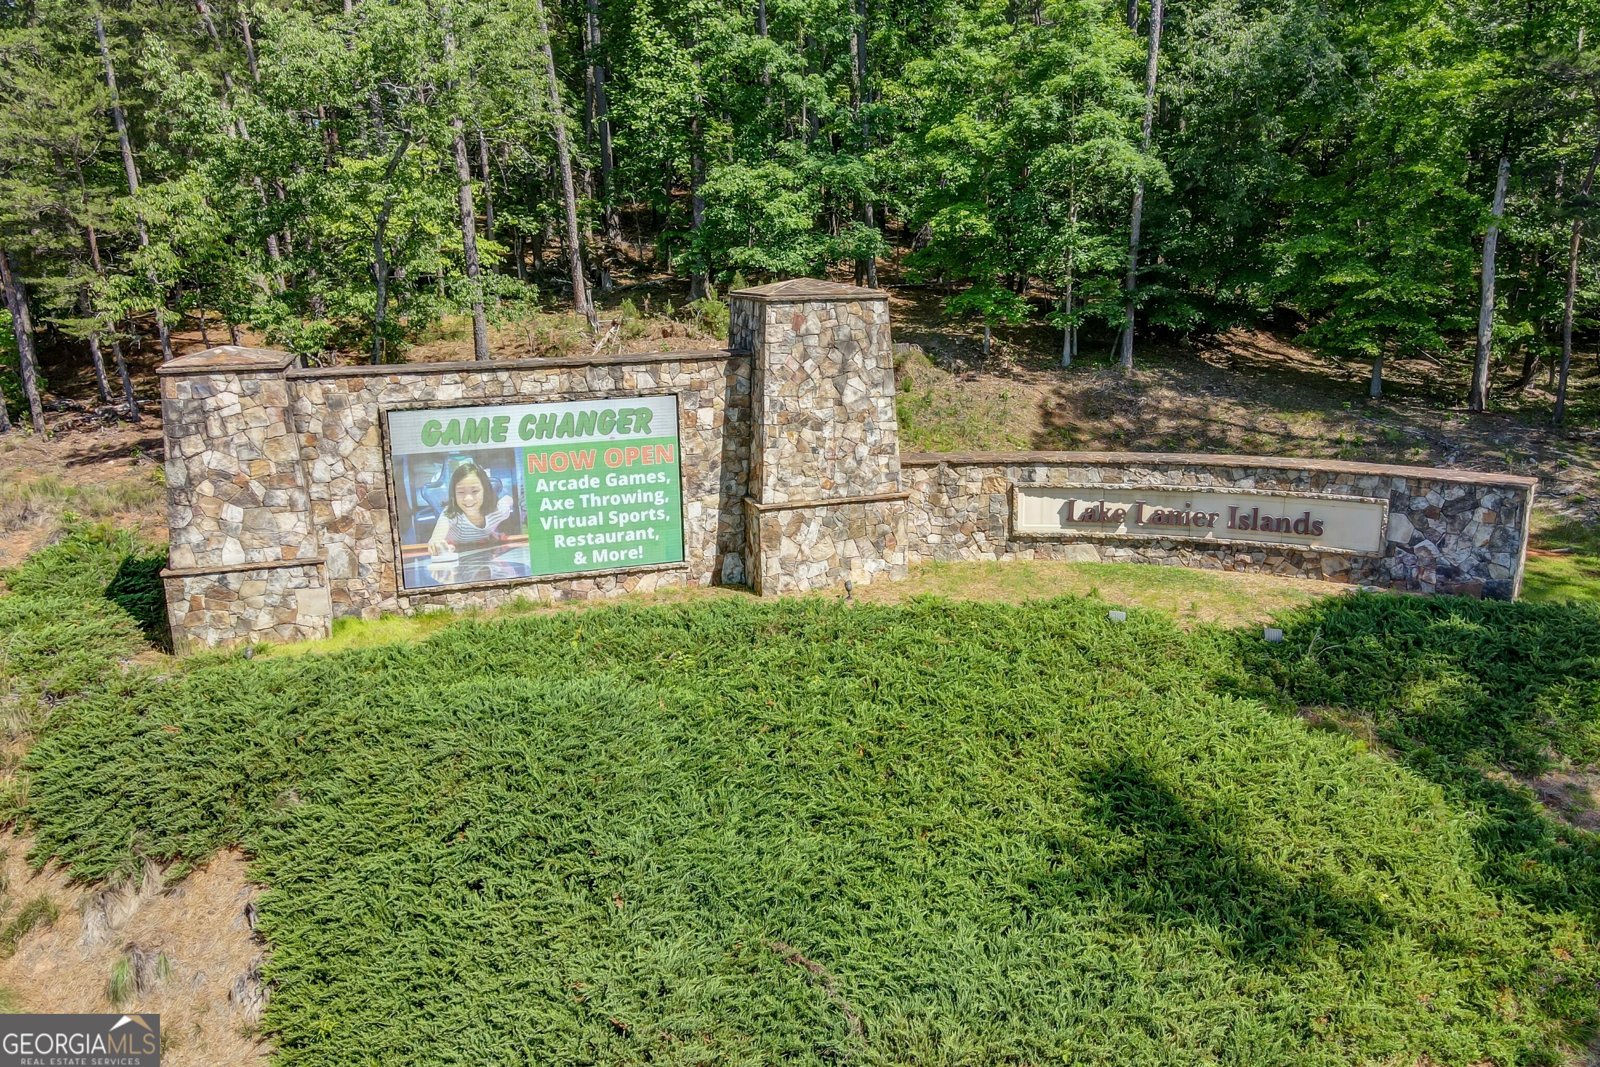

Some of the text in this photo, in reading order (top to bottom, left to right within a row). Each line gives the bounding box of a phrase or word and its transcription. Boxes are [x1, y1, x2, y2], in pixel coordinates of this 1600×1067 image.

[421, 407, 653, 447] GAME CHANGER
[527, 444, 674, 474] NOW OPEN
[536, 472, 671, 492] Arcade Games,
[540, 489, 669, 511] Axe Throwing,
[540, 507, 670, 530] Virtual Sports,
[1065, 498, 1324, 537] Lake Lanier Islands
[554, 528, 660, 548] Restaurant,
[573, 546, 643, 565] & More!
